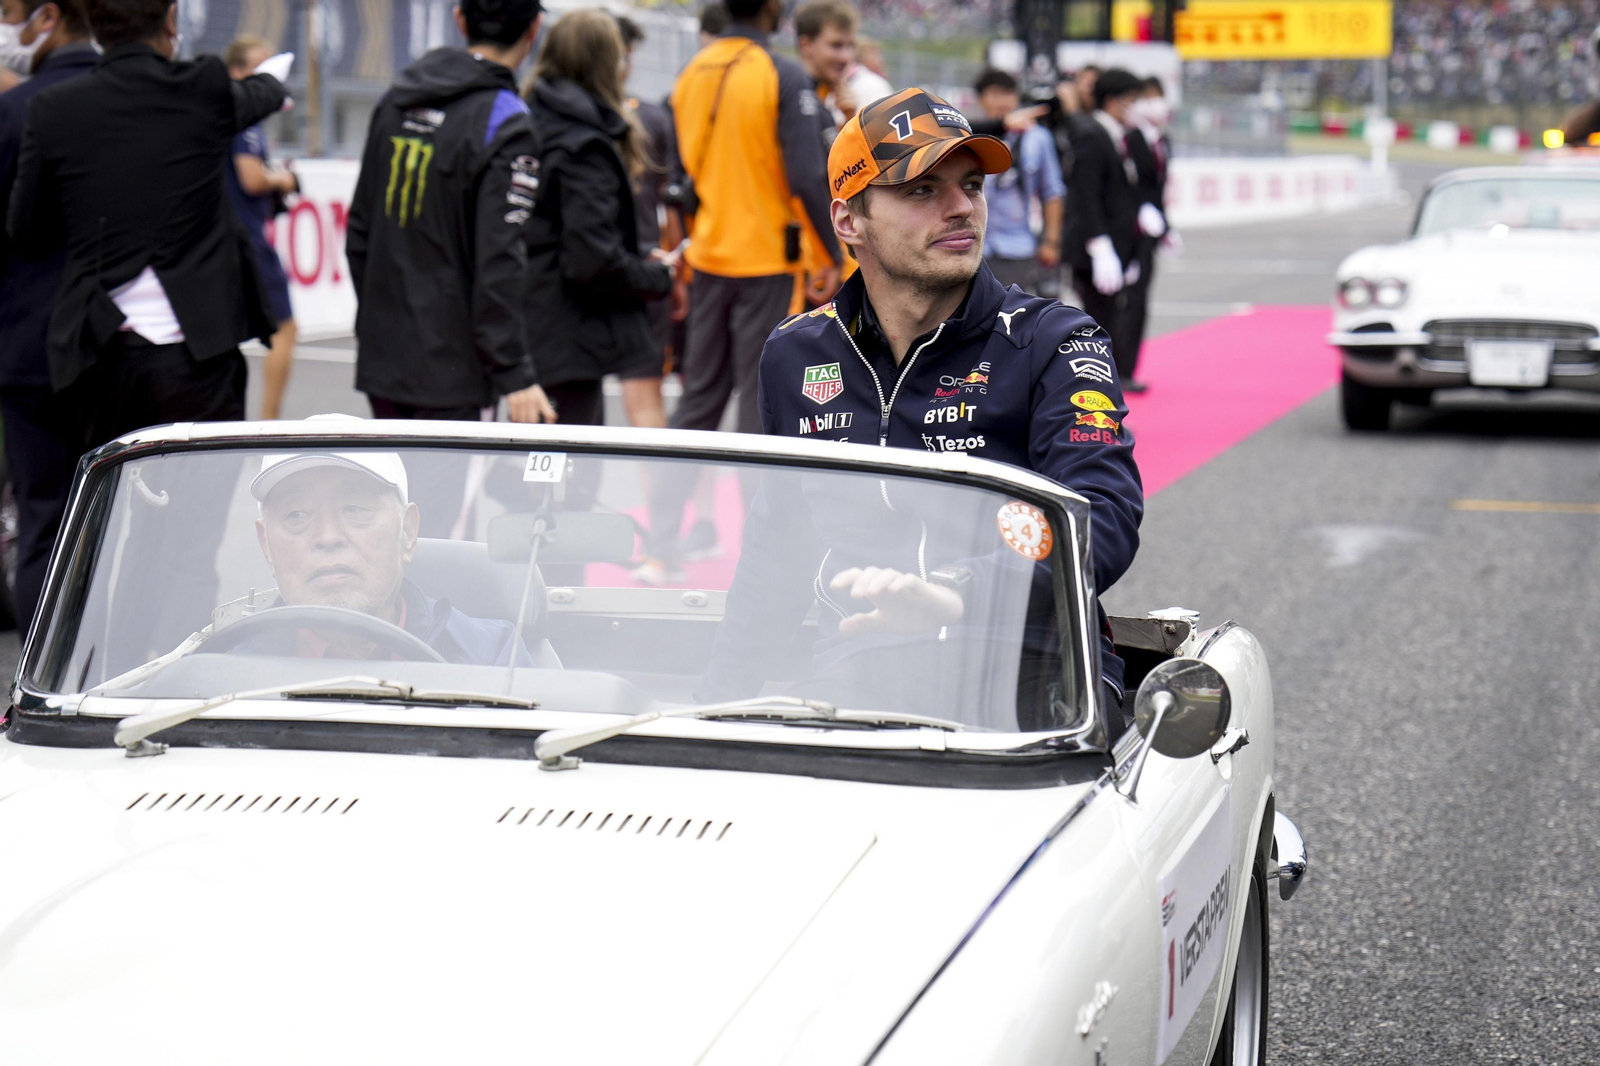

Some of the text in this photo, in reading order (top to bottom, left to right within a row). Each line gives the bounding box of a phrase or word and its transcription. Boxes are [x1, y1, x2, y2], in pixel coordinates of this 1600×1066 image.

[889, 110, 913, 141] 1
[834, 158, 867, 192] CarNext
[808, 366, 839, 381] TAG
[805, 382, 842, 402] HEUER
[799, 412, 834, 435] Mobil
[923, 402, 977, 424] BYBIT
[935, 434, 986, 451] Tezos
[528, 454, 552, 472] 10
[1020, 523, 1033, 541] 4
[1179, 864, 1231, 988] VERSTAPPEN
[1167, 937, 1176, 1022] 1
